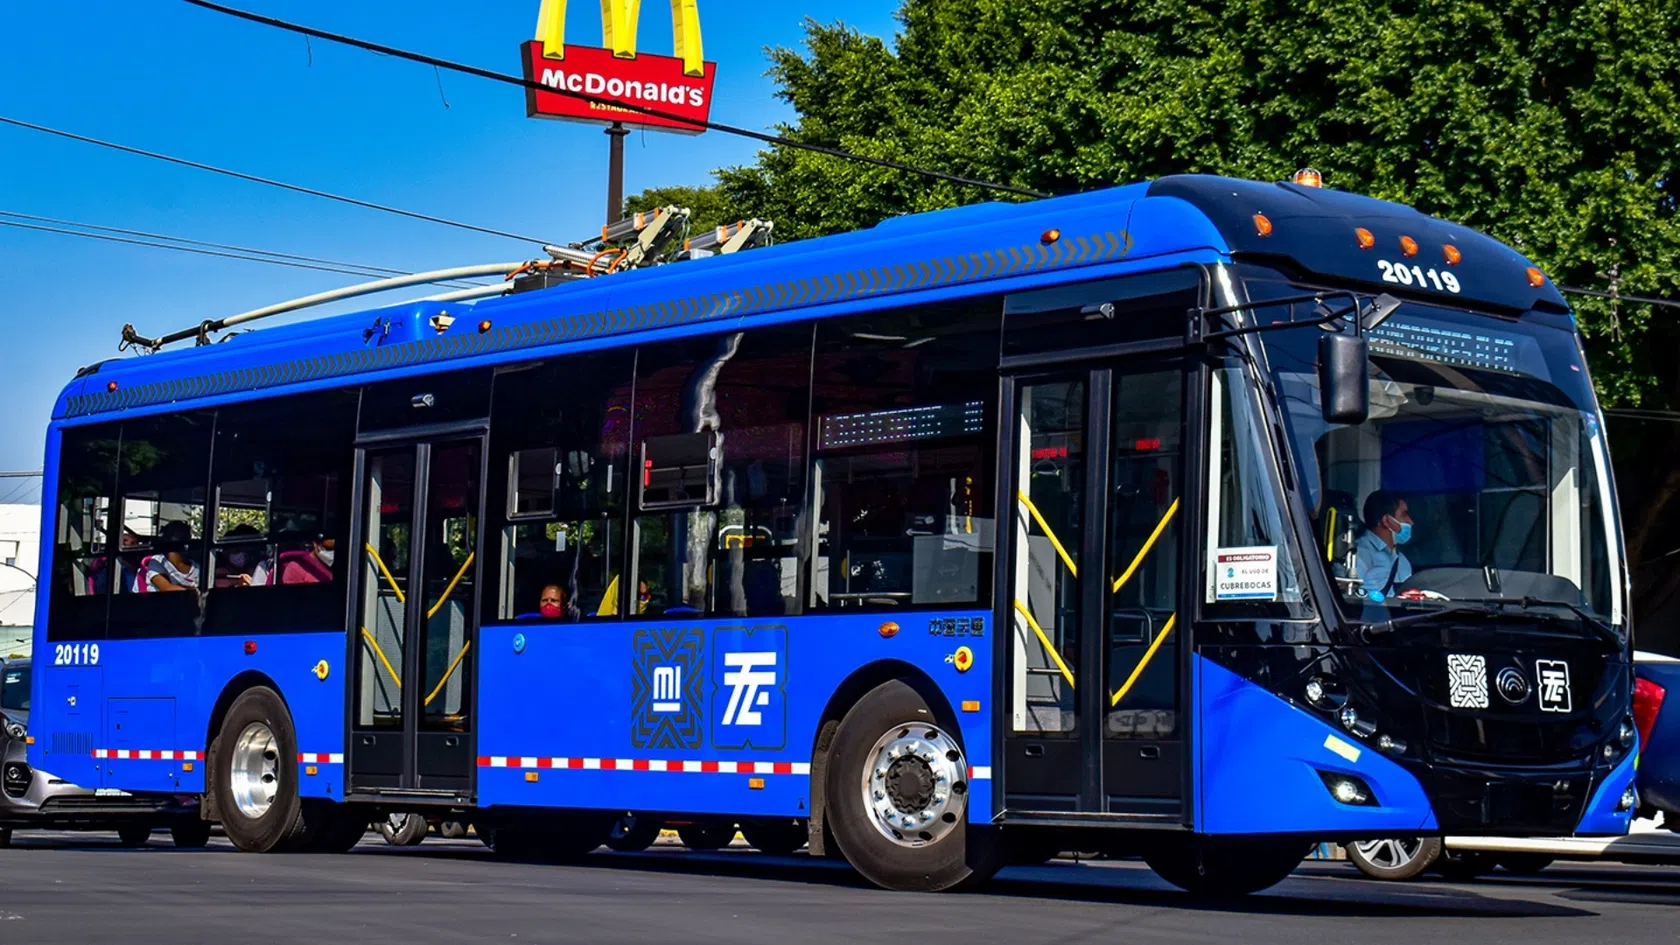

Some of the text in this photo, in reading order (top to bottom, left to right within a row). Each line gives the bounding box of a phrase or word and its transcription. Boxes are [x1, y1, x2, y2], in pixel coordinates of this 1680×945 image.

[541, 68, 704, 107] McDonald's
[1377, 259, 1461, 294] 20119
[1220, 581, 1272, 590] CUBREBOCAS
[54, 643, 100, 665] 20119
